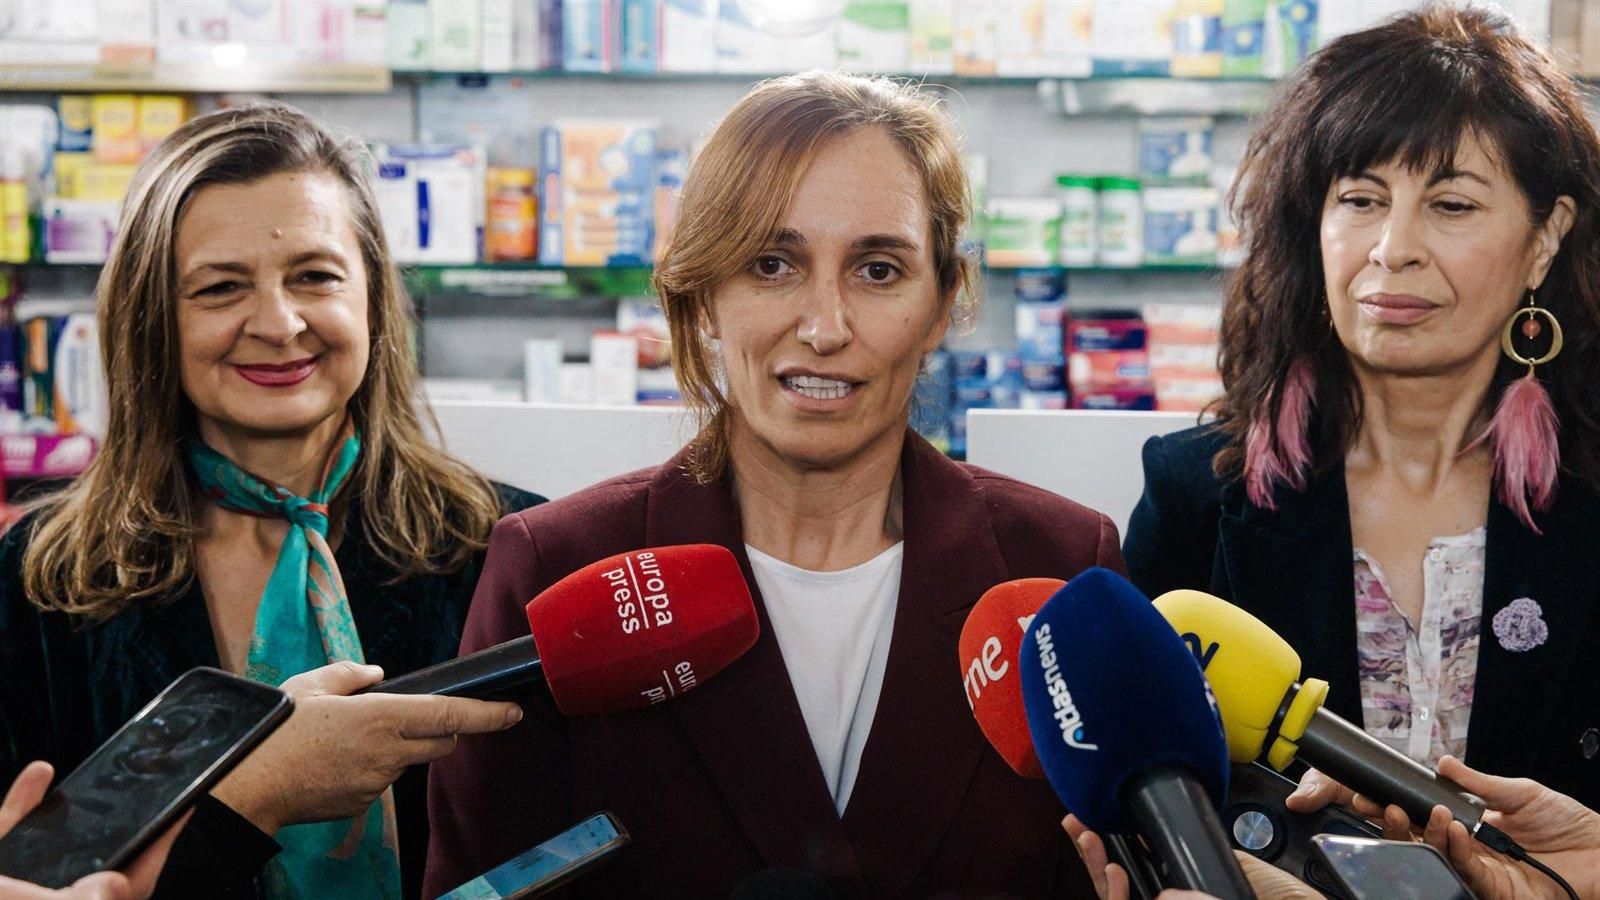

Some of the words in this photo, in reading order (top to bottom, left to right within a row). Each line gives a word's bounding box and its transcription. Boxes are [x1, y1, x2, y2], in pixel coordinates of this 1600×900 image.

[601, 567, 640, 635] press
[636, 551, 673, 627] europa
[963, 635, 1009, 712] rne
[1034, 622, 1099, 751] Atlasnews
